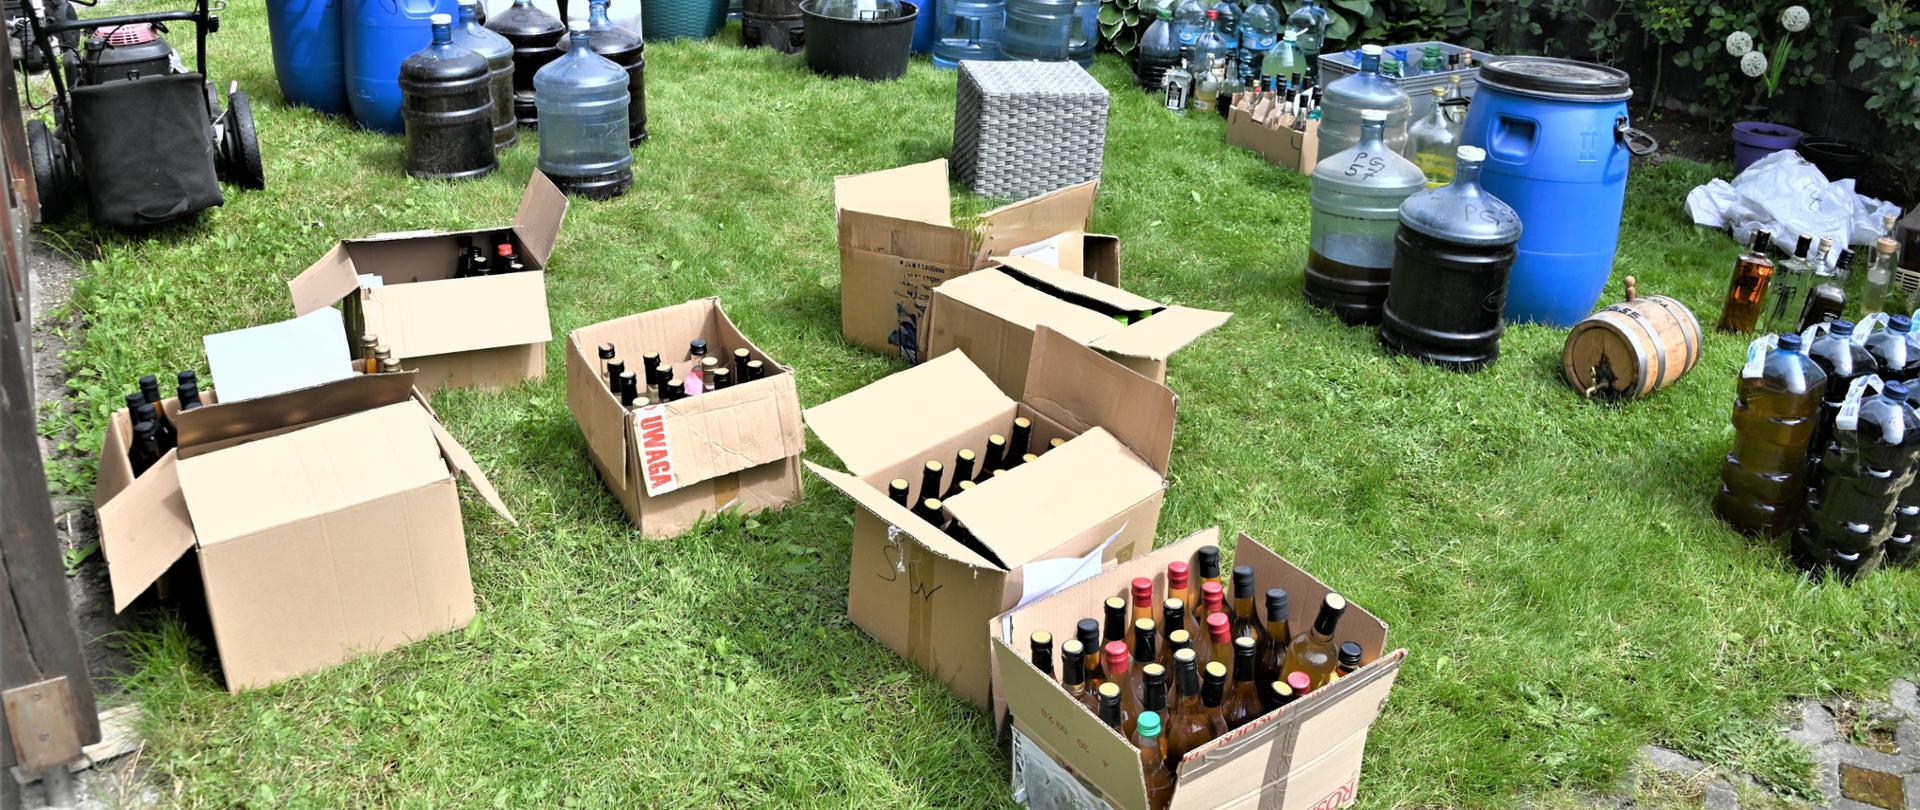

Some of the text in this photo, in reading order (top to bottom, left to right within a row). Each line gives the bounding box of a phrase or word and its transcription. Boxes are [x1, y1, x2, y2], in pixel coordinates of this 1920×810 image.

[1344, 163, 1379, 181] 57
[1353, 152, 1386, 172] PG
[640, 415, 672, 489] UWAGA
